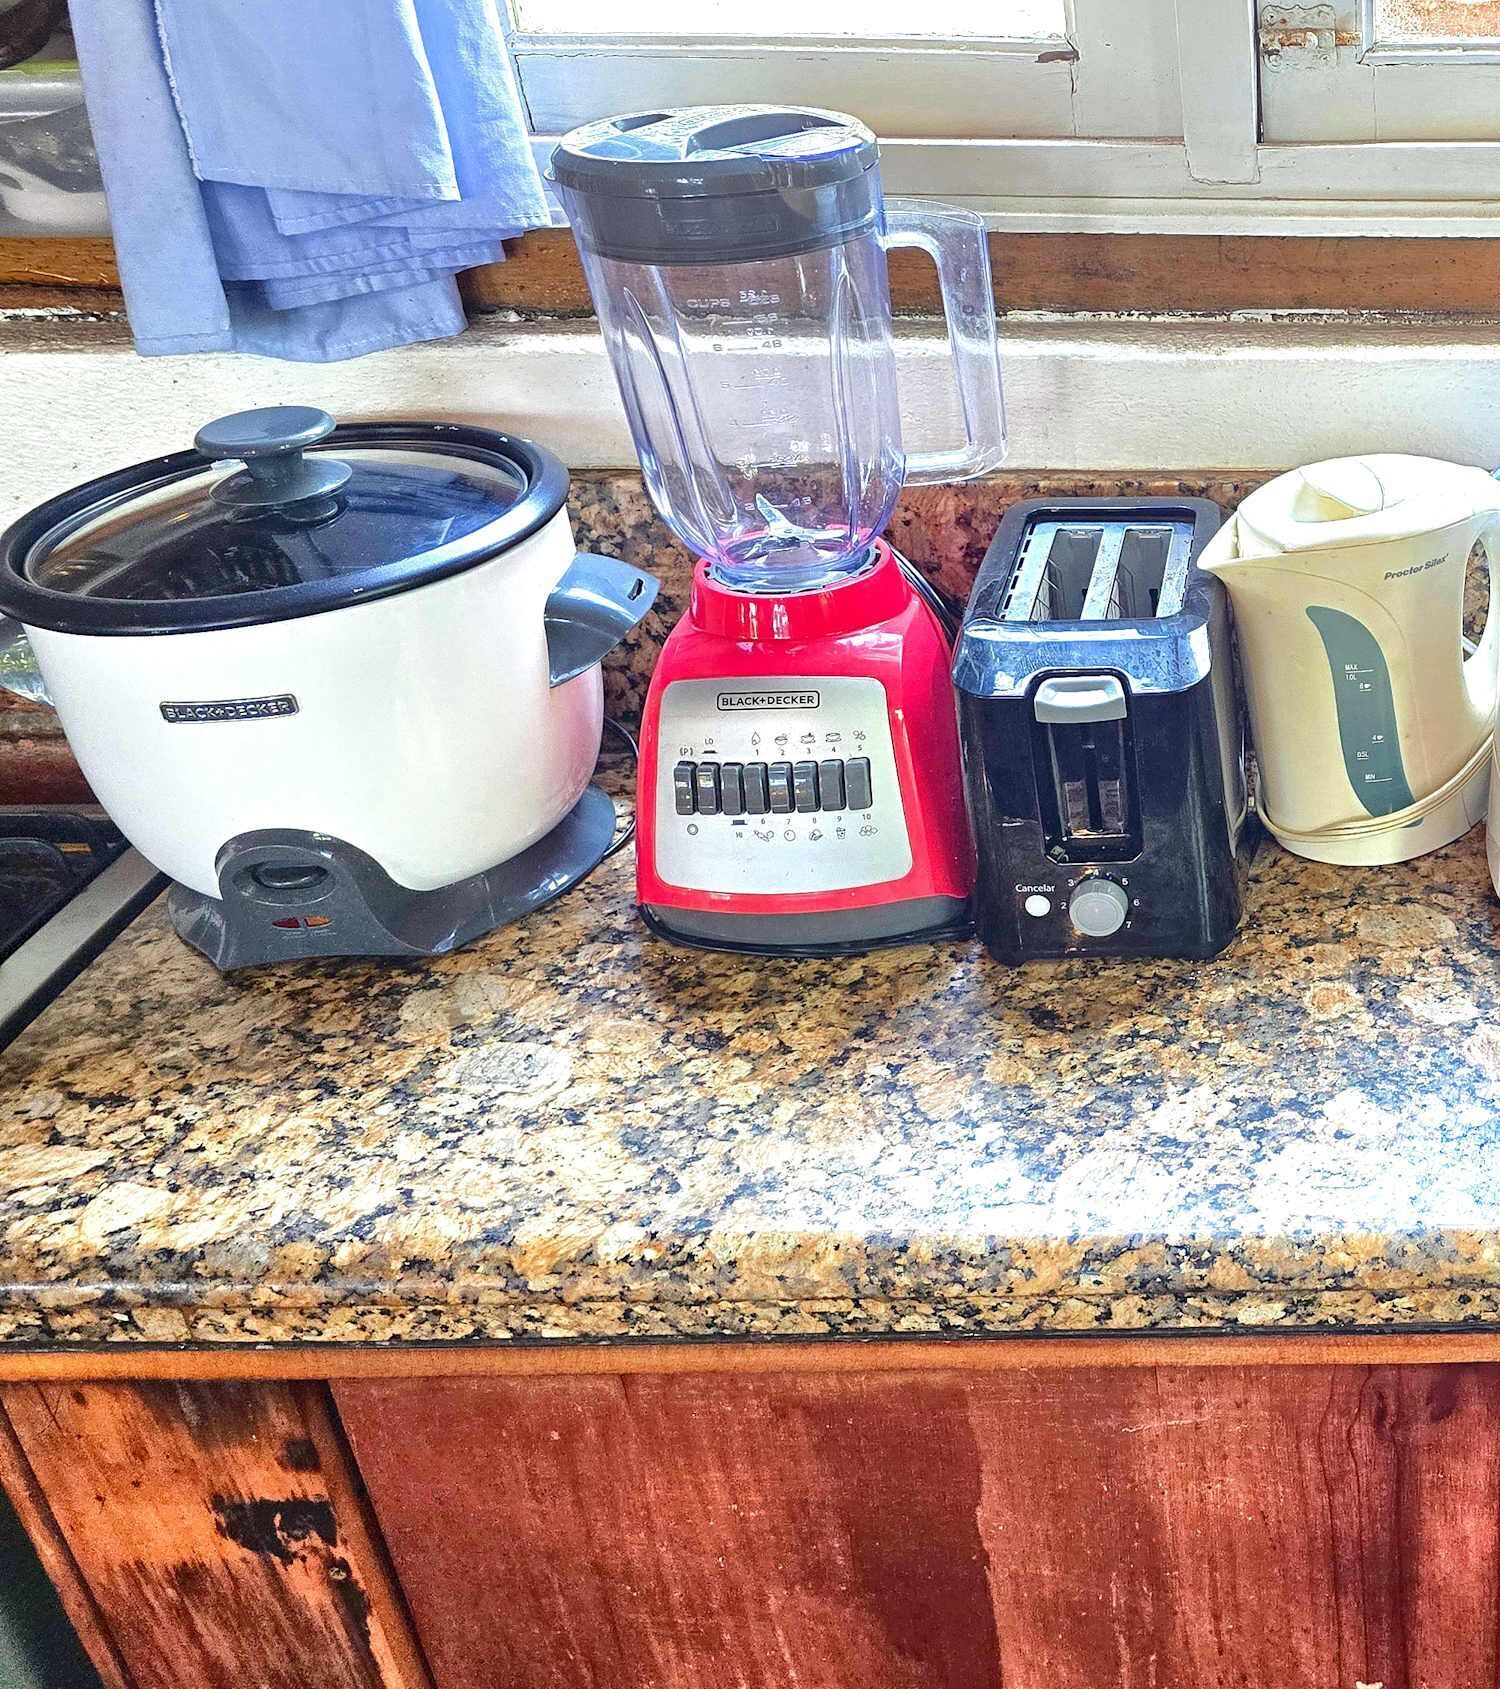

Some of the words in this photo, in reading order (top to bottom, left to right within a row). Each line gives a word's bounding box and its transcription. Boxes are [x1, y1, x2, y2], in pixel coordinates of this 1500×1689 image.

[1384, 565, 1424, 580] Proctor
[1424, 555, 1446, 570] Silex
[721, 694, 815, 707] BLACK+DECKER
[165, 700, 290, 719] BLACK+DECKER
[1067, 879, 1075, 887] 3
[1122, 877, 1129, 886] 5
[1015, 884, 1055, 893] Cancelar
[1060, 902, 1067, 910] 2
[1133, 898, 1140, 907] 6
[1126, 920, 1132, 929] 7
